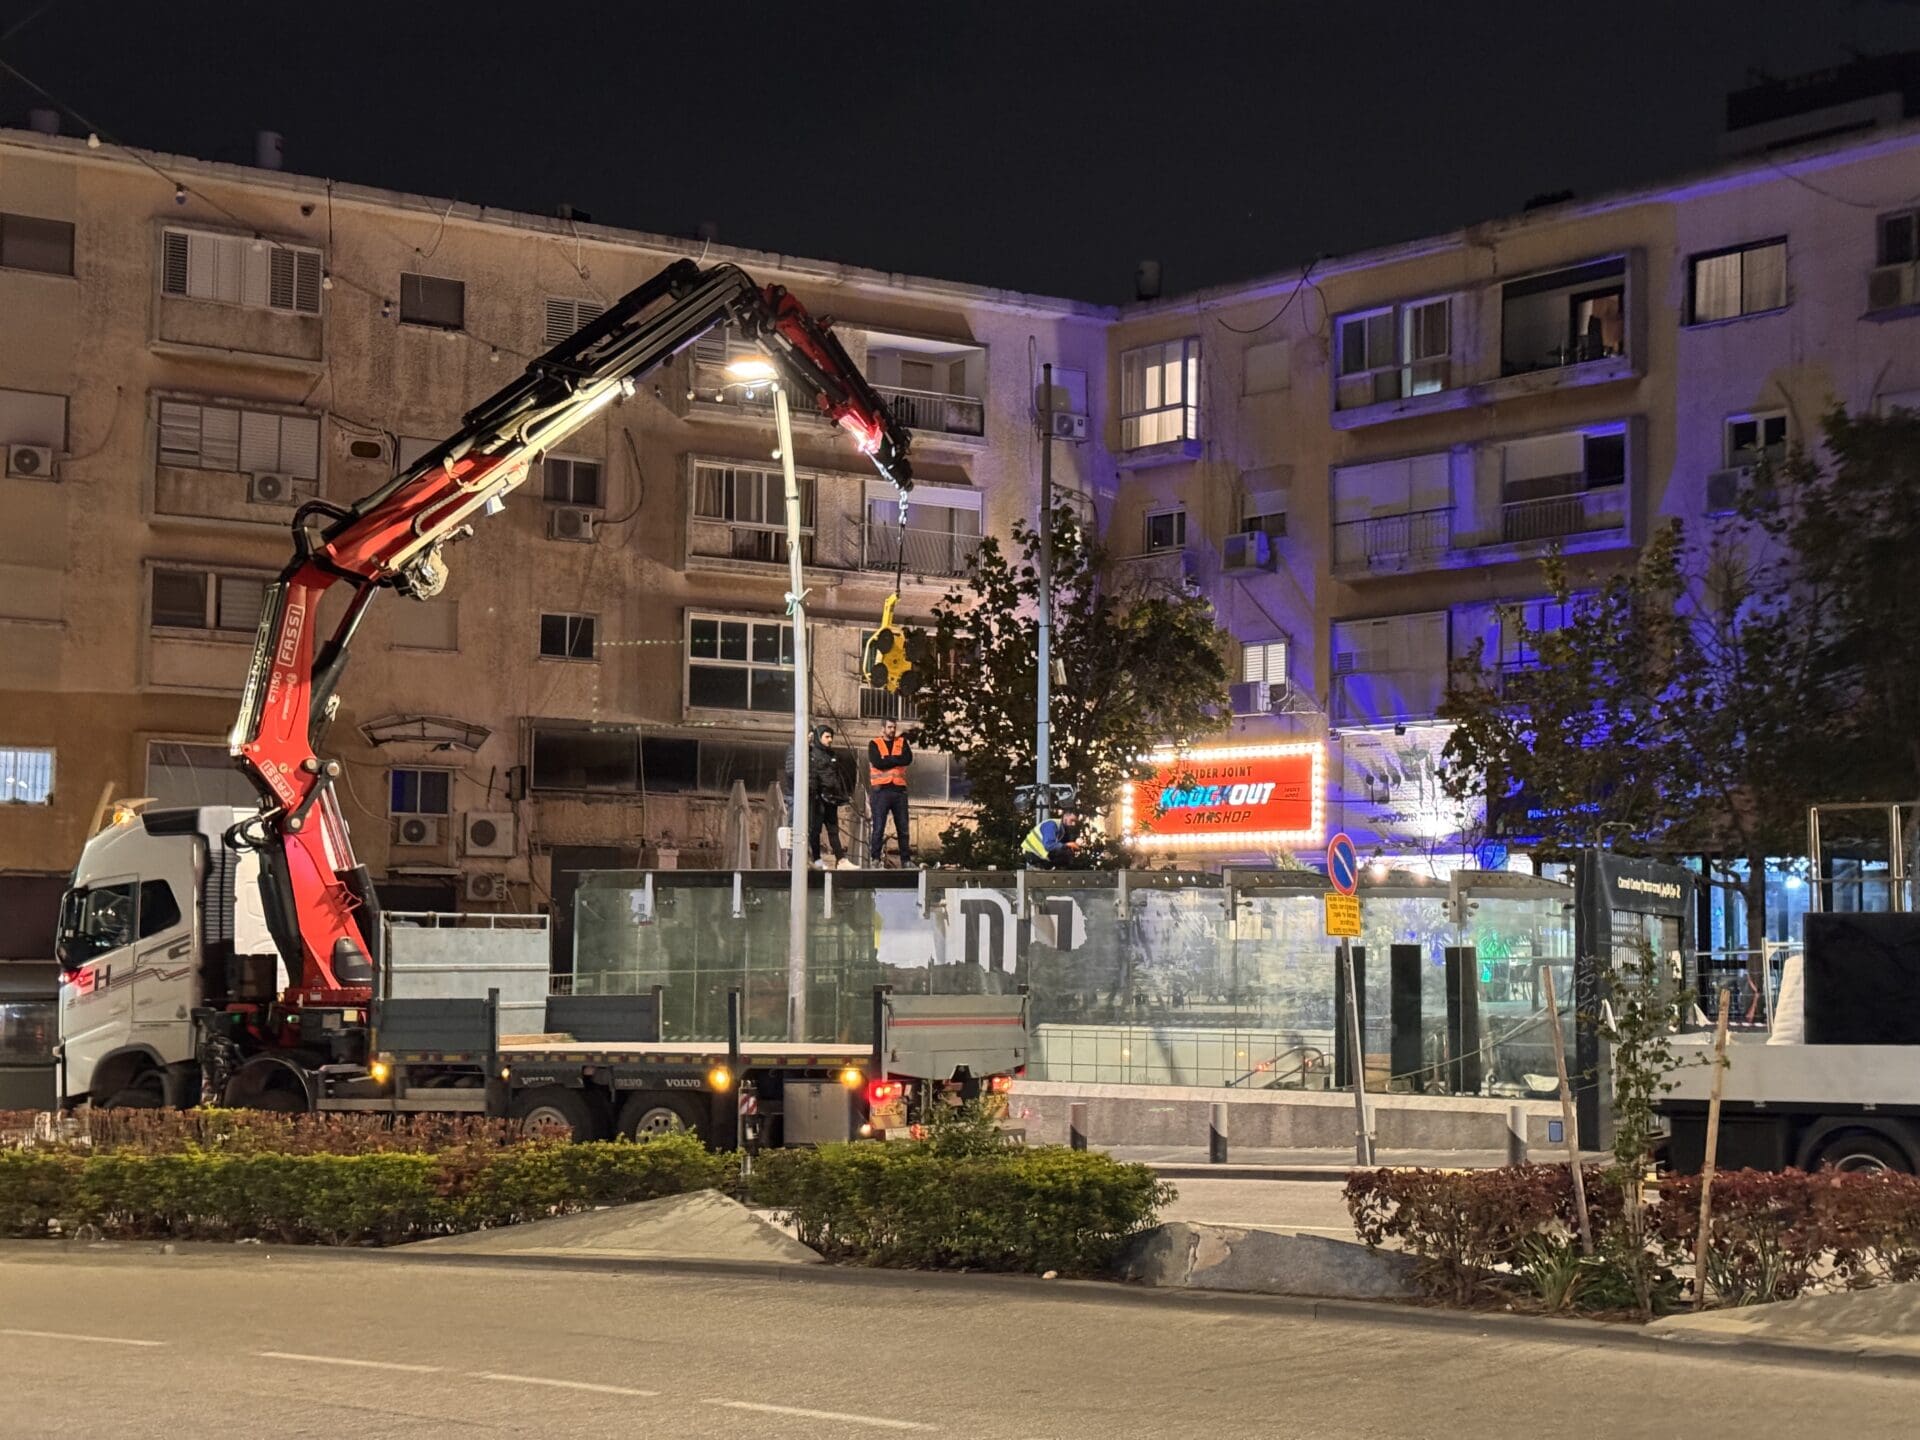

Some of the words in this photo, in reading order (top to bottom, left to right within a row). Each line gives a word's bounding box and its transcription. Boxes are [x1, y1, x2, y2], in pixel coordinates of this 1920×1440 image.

[281, 608, 303, 662] FASSI
[263, 763, 293, 799] FASSI
[1221, 766, 1252, 778] JOINT
[615, 1078, 643, 1087] OLVO
[665, 1078, 701, 1087] VOLVO
